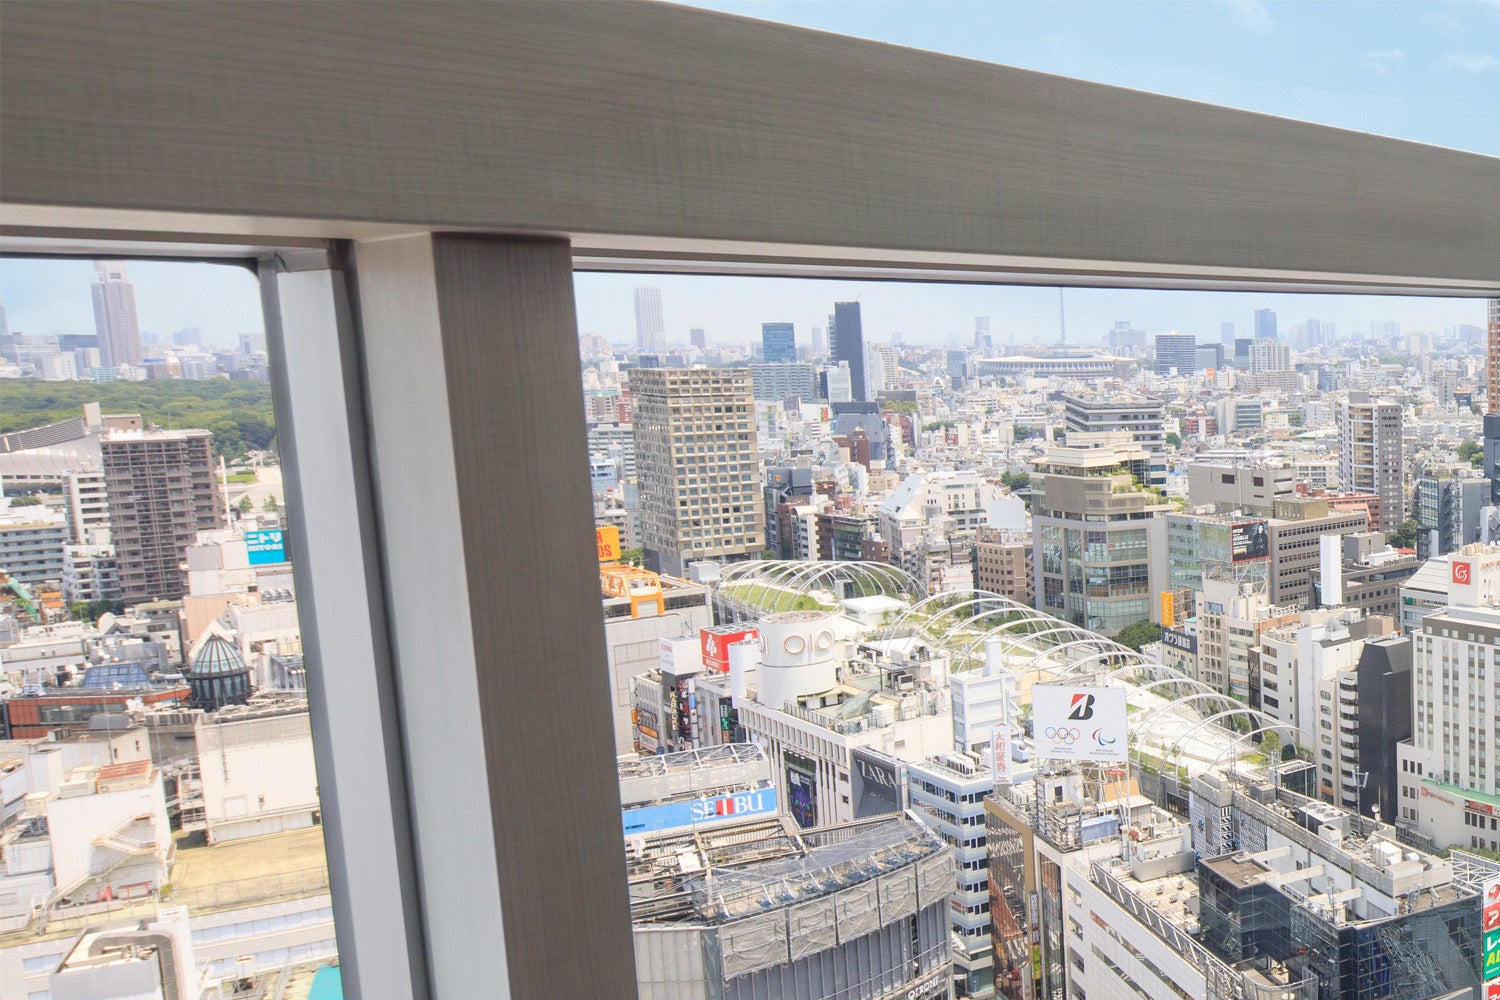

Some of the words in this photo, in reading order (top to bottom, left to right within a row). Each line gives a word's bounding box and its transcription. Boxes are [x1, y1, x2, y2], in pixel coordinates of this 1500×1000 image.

[247, 532, 281, 544] ニトリ
[248, 543, 282, 551] NITORI
[857, 759, 896, 789] ZARA
[691, 794, 764, 821] SEIBU
